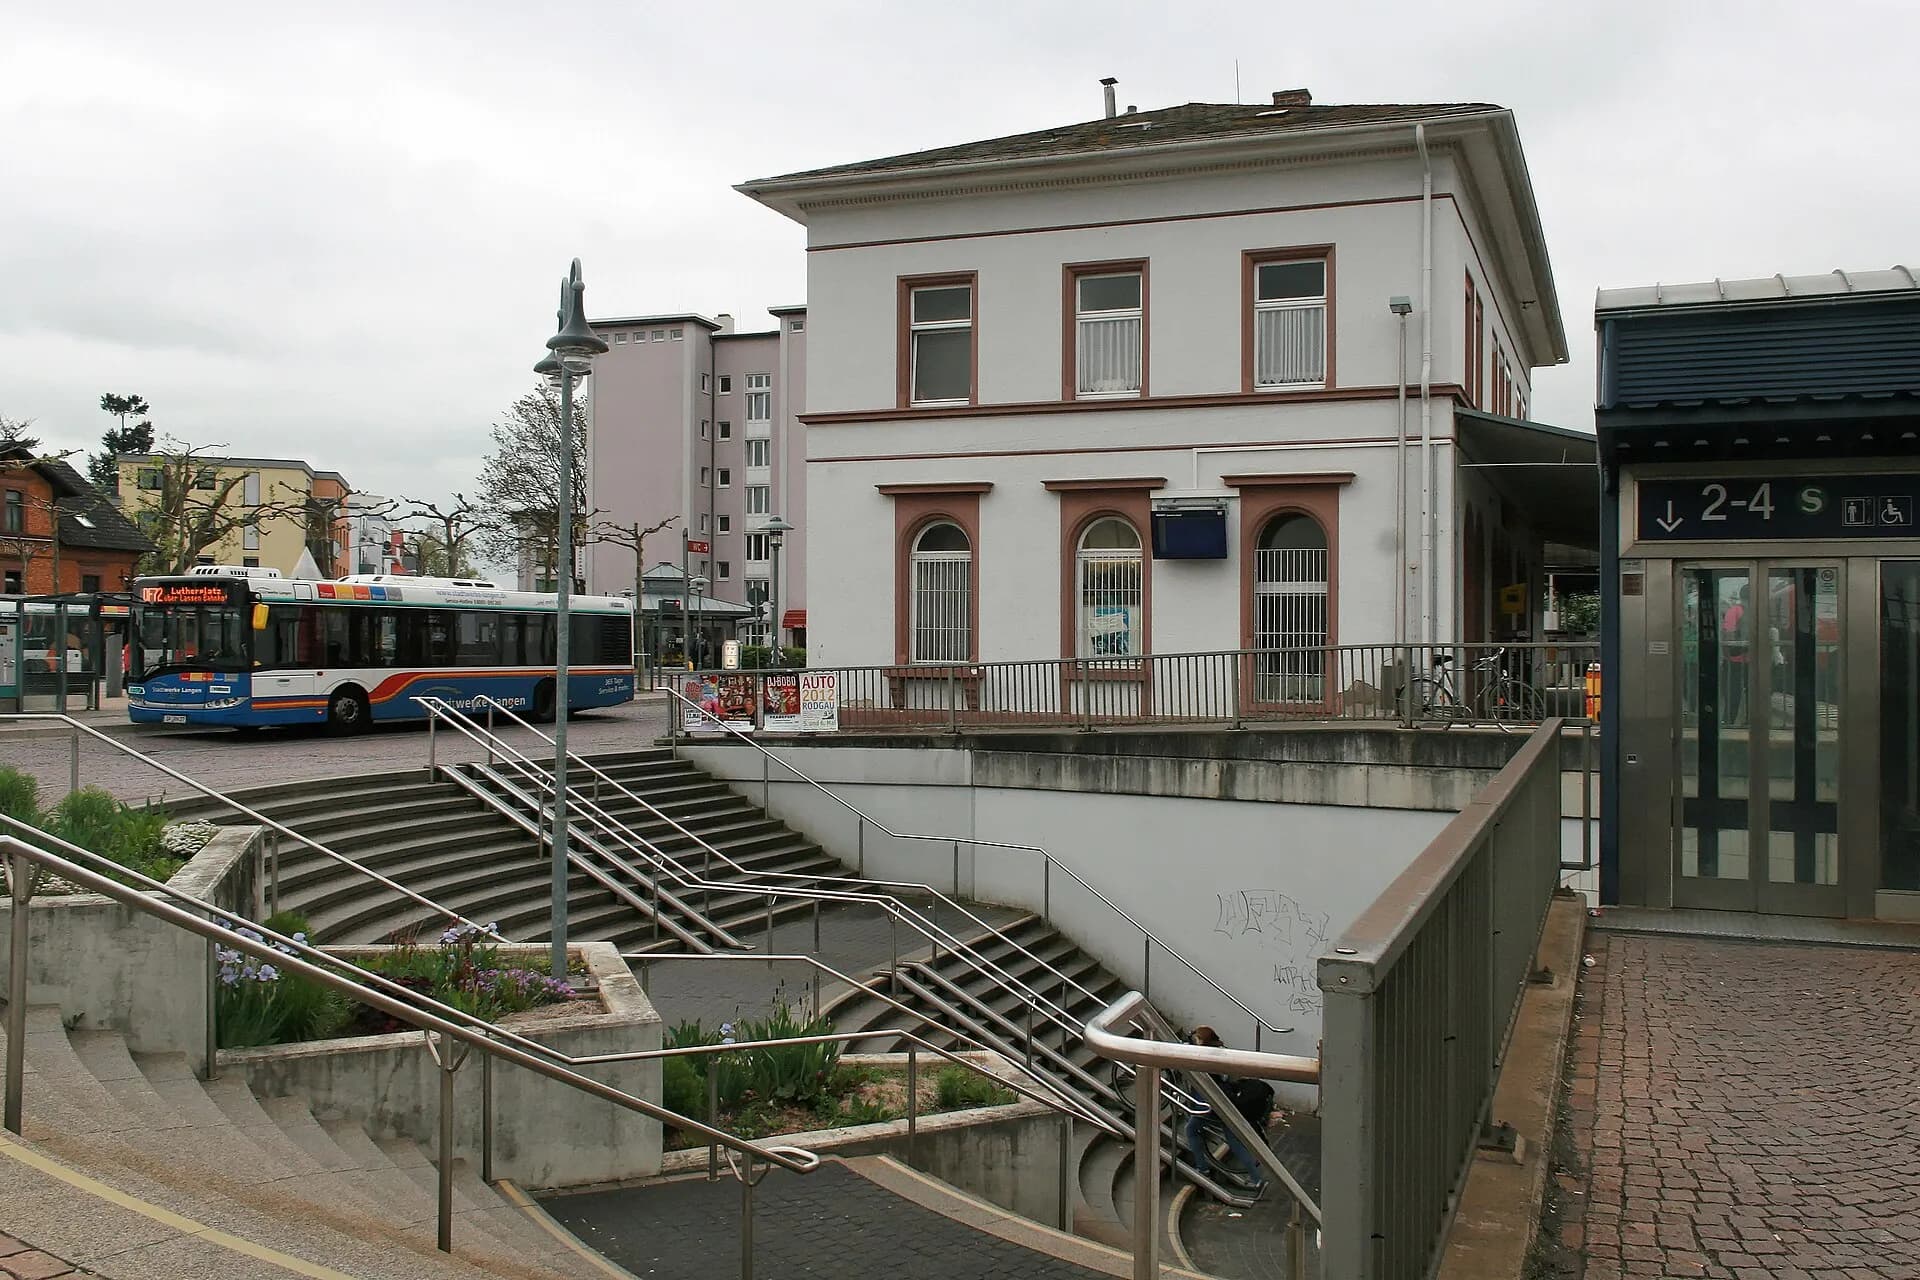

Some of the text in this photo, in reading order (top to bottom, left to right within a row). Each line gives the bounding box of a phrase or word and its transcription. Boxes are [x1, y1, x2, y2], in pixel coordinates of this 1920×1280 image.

[1702, 483, 1823, 520] 2-4 S
[171, 587, 222, 595] Lutherplatz
[802, 675, 835, 689] AUTO
[802, 689, 835, 701] 2012
[430, 698, 487, 709] dtwerke
[802, 702, 834, 710] RODGAU
